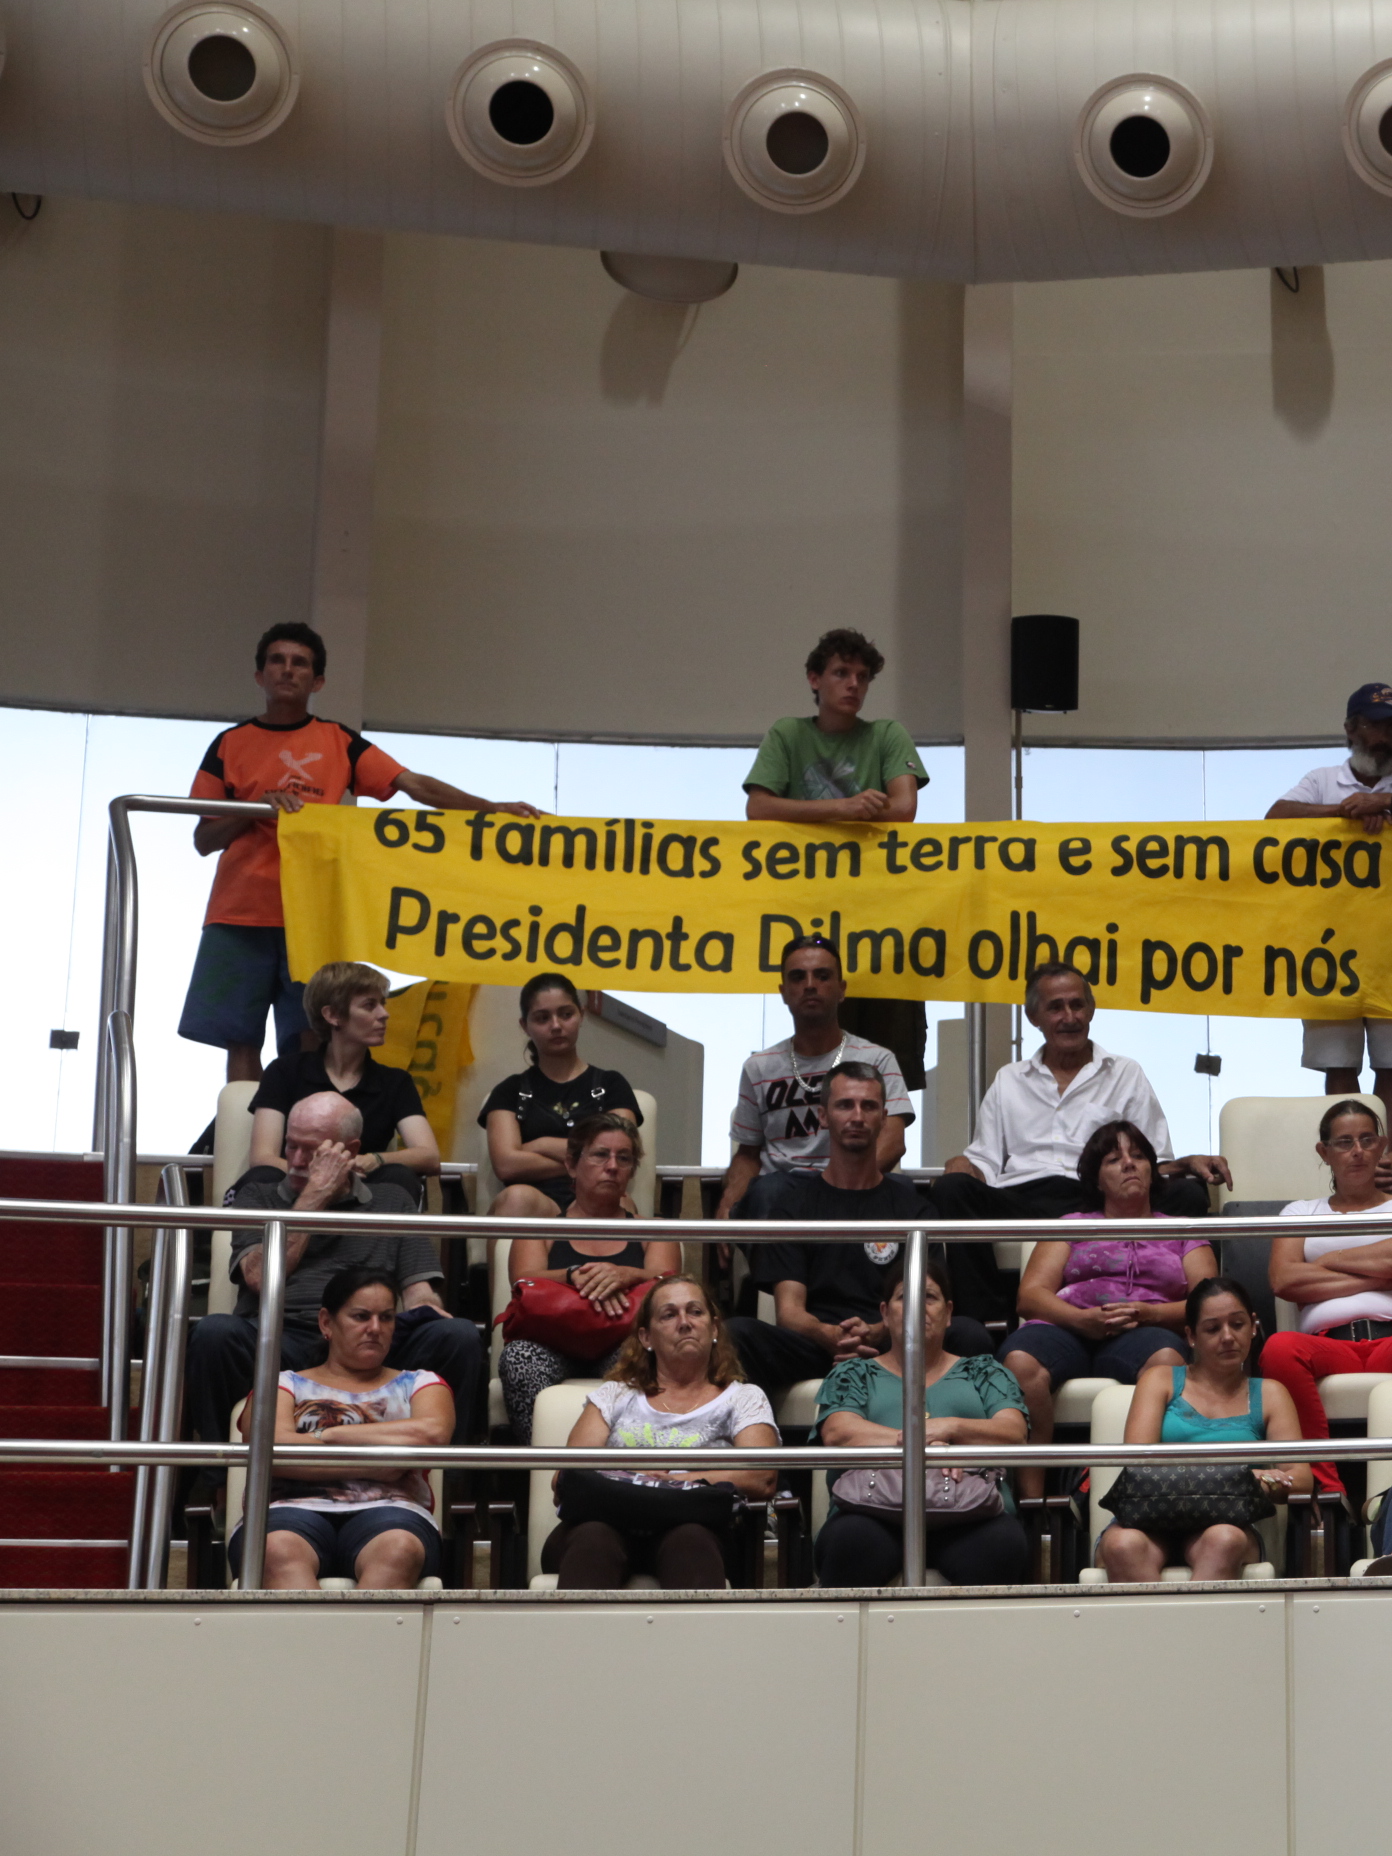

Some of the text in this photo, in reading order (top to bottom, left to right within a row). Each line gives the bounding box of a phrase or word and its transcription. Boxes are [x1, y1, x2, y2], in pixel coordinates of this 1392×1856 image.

[373, 809, 1383, 889] 65 famílias sem terra e sem casa
[384, 886, 736, 973] Presidenta
[967, 910, 1120, 986] olhai
[1140, 938, 1244, 1005] por
[1263, 927, 1361, 997] nós
